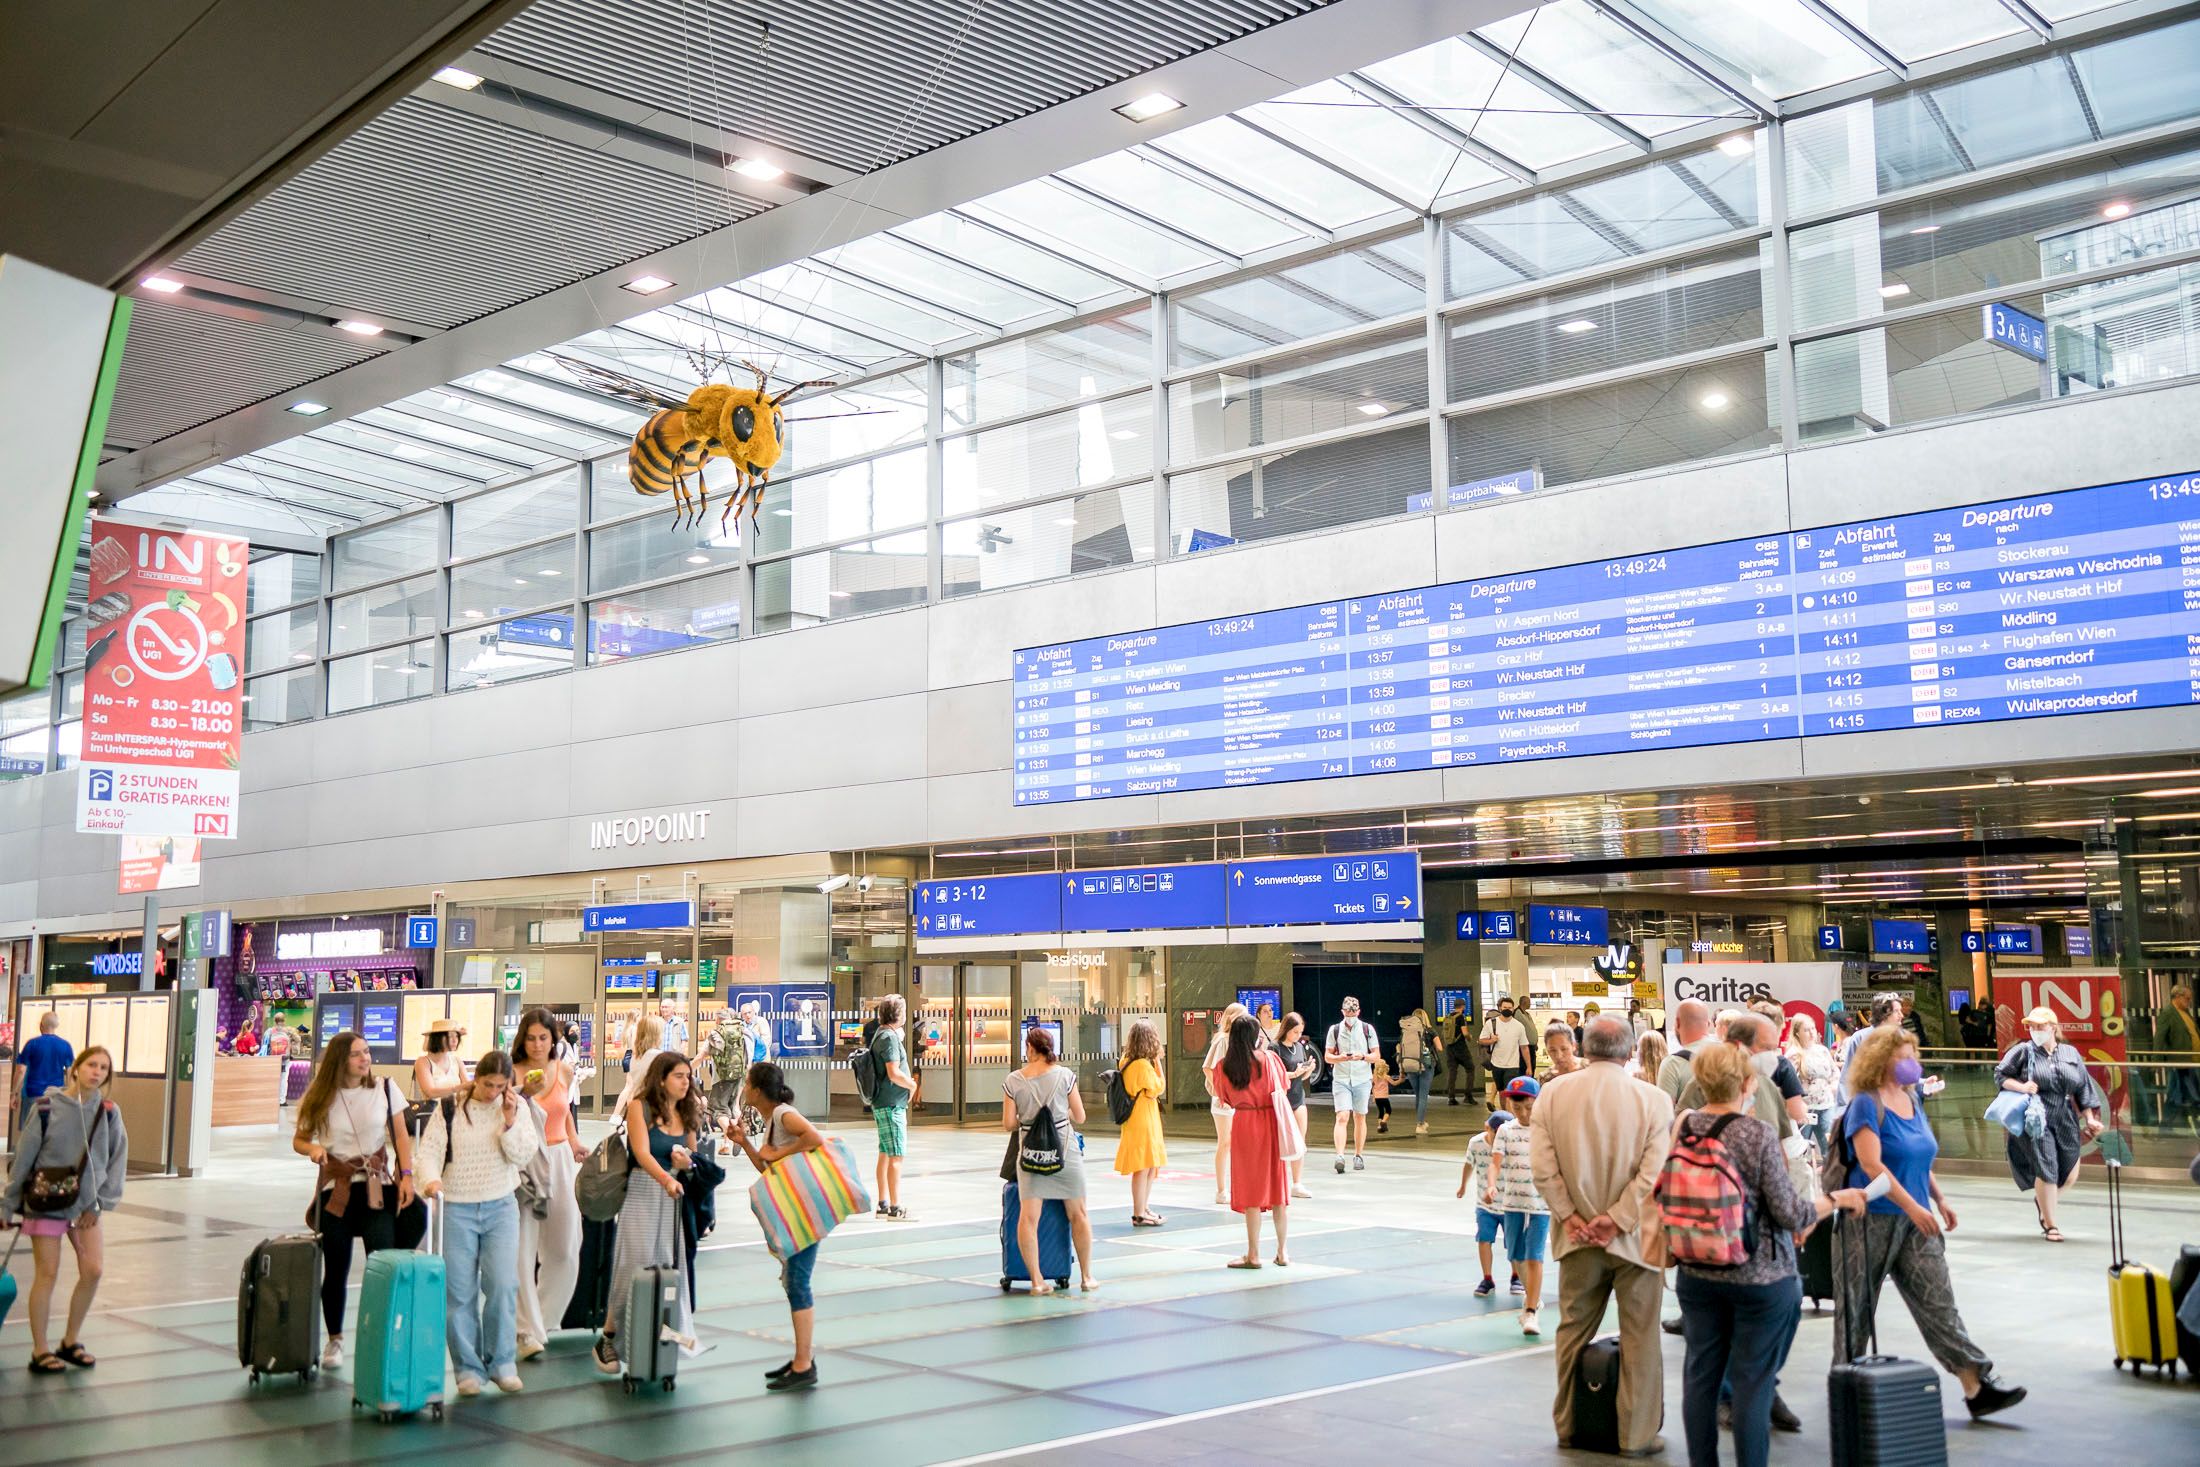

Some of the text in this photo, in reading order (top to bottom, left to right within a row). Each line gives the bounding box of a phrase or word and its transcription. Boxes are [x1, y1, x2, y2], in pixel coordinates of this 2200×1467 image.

[1996, 312, 2016, 341] 3 A
[1818, 523, 2019, 558] Zeit Erwartet Zug nach
[1834, 502, 2053, 545] Abfahrt Departure
[139, 533, 203, 574] IN
[1819, 536, 2006, 570] time estimated train to
[1820, 545, 2069, 586] 14:09 R3 Stockerau
[1378, 557, 1666, 611] Abfahrt Departure 13:49:24
[1450, 557, 1778, 611] Zug nach Bahnsteig
[1495, 569, 1773, 614] to platform
[1821, 553, 2162, 606] 14:10 EC 102 Warszawa Wschodnia
[1368, 584, 1782, 646] 13:56 W. Aspern Nord 3 A-B
[1823, 579, 2122, 627] 14:11 Wr.Neustadt Hbf
[143, 638, 155, 647] im
[611, 643, 619, 651] 3
[1037, 618, 1254, 662] Abfahrt Departure 13:49:24
[1368, 603, 1764, 664] 13:57 S4 Absdorf-Hippersdorf 2
[1452, 663, 1461, 671] RJ
[1497, 654, 1520, 665] Graz
[1525, 650, 1543, 662] Hbf
[1768, 623, 1785, 633] A-B
[1824, 611, 2056, 647] 14:11 S2 Mödling
[1825, 627, 2116, 667] 14:12 RJ Flughafen Wien
[143, 650, 161, 660] UG1
[1369, 642, 1764, 699] 13:59 REX1 Wr.Neustadt Hbf 1
[1826, 649, 2094, 687] 14:12 S1 Gänserndorf
[1029, 697, 1048, 707] 13:47
[1125, 686, 1146, 694] Wien
[1148, 681, 1180, 692] Meidling
[1321, 660, 1324, 669] 1
[1369, 704, 1395, 716] 14:00
[1453, 698, 1473, 706] REX1
[1760, 663, 1767, 674] 2
[1827, 674, 2082, 708] 14:15 S2 Mistelbach
[93, 694, 232, 715] Mo Fr 8.30 21.00
[1029, 695, 1325, 738] 13:50 Liesing 1
[1369, 683, 1767, 734] 14:02 S3 Wr.Neustadt Hbf 1
[1828, 690, 2138, 729] 14:15 REX64 Wulkaprodersdorf
[91, 732, 226, 750] Zum INTERSPAR-Hypermarkt
[92, 713, 232, 733] Sa 8.30 18.00
[1370, 703, 1789, 751] 14:05 Wien Hütteldorf 3 A-B
[105, 746, 172, 757] Untergeschoß
[176, 749, 194, 758] UG1
[1029, 760, 1048, 769] 13:51
[1127, 748, 1165, 758] Marchegg
[1316, 729, 1327, 739] 12
[1370, 723, 1768, 769] 14:08 REX3 Payerbach-R. 1
[120, 775, 198, 789] 2 STUNDEN
[1127, 763, 1328, 791] Salzburg Hbf 7
[88, 808, 101, 817] Ab
[105, 809, 110, 817] €
[119, 791, 230, 808] GRATIS PARKEN!
[88, 819, 124, 829] Einkauf
[196, 815, 226, 833] IN
[591, 809, 711, 849] INFOPOINT
[1254, 874, 1322, 886] Sonnwendgasse
[604, 917, 626, 925] InfoPoint
[964, 920, 976, 929] WC
[1334, 904, 1365, 913] Tickets
[1462, 917, 1473, 934] 4
[1824, 930, 1834, 946] 5
[1967, 936, 1976, 950] 6
[1674, 977, 1771, 1002] Caritas
[2021, 980, 2091, 1019] IN
